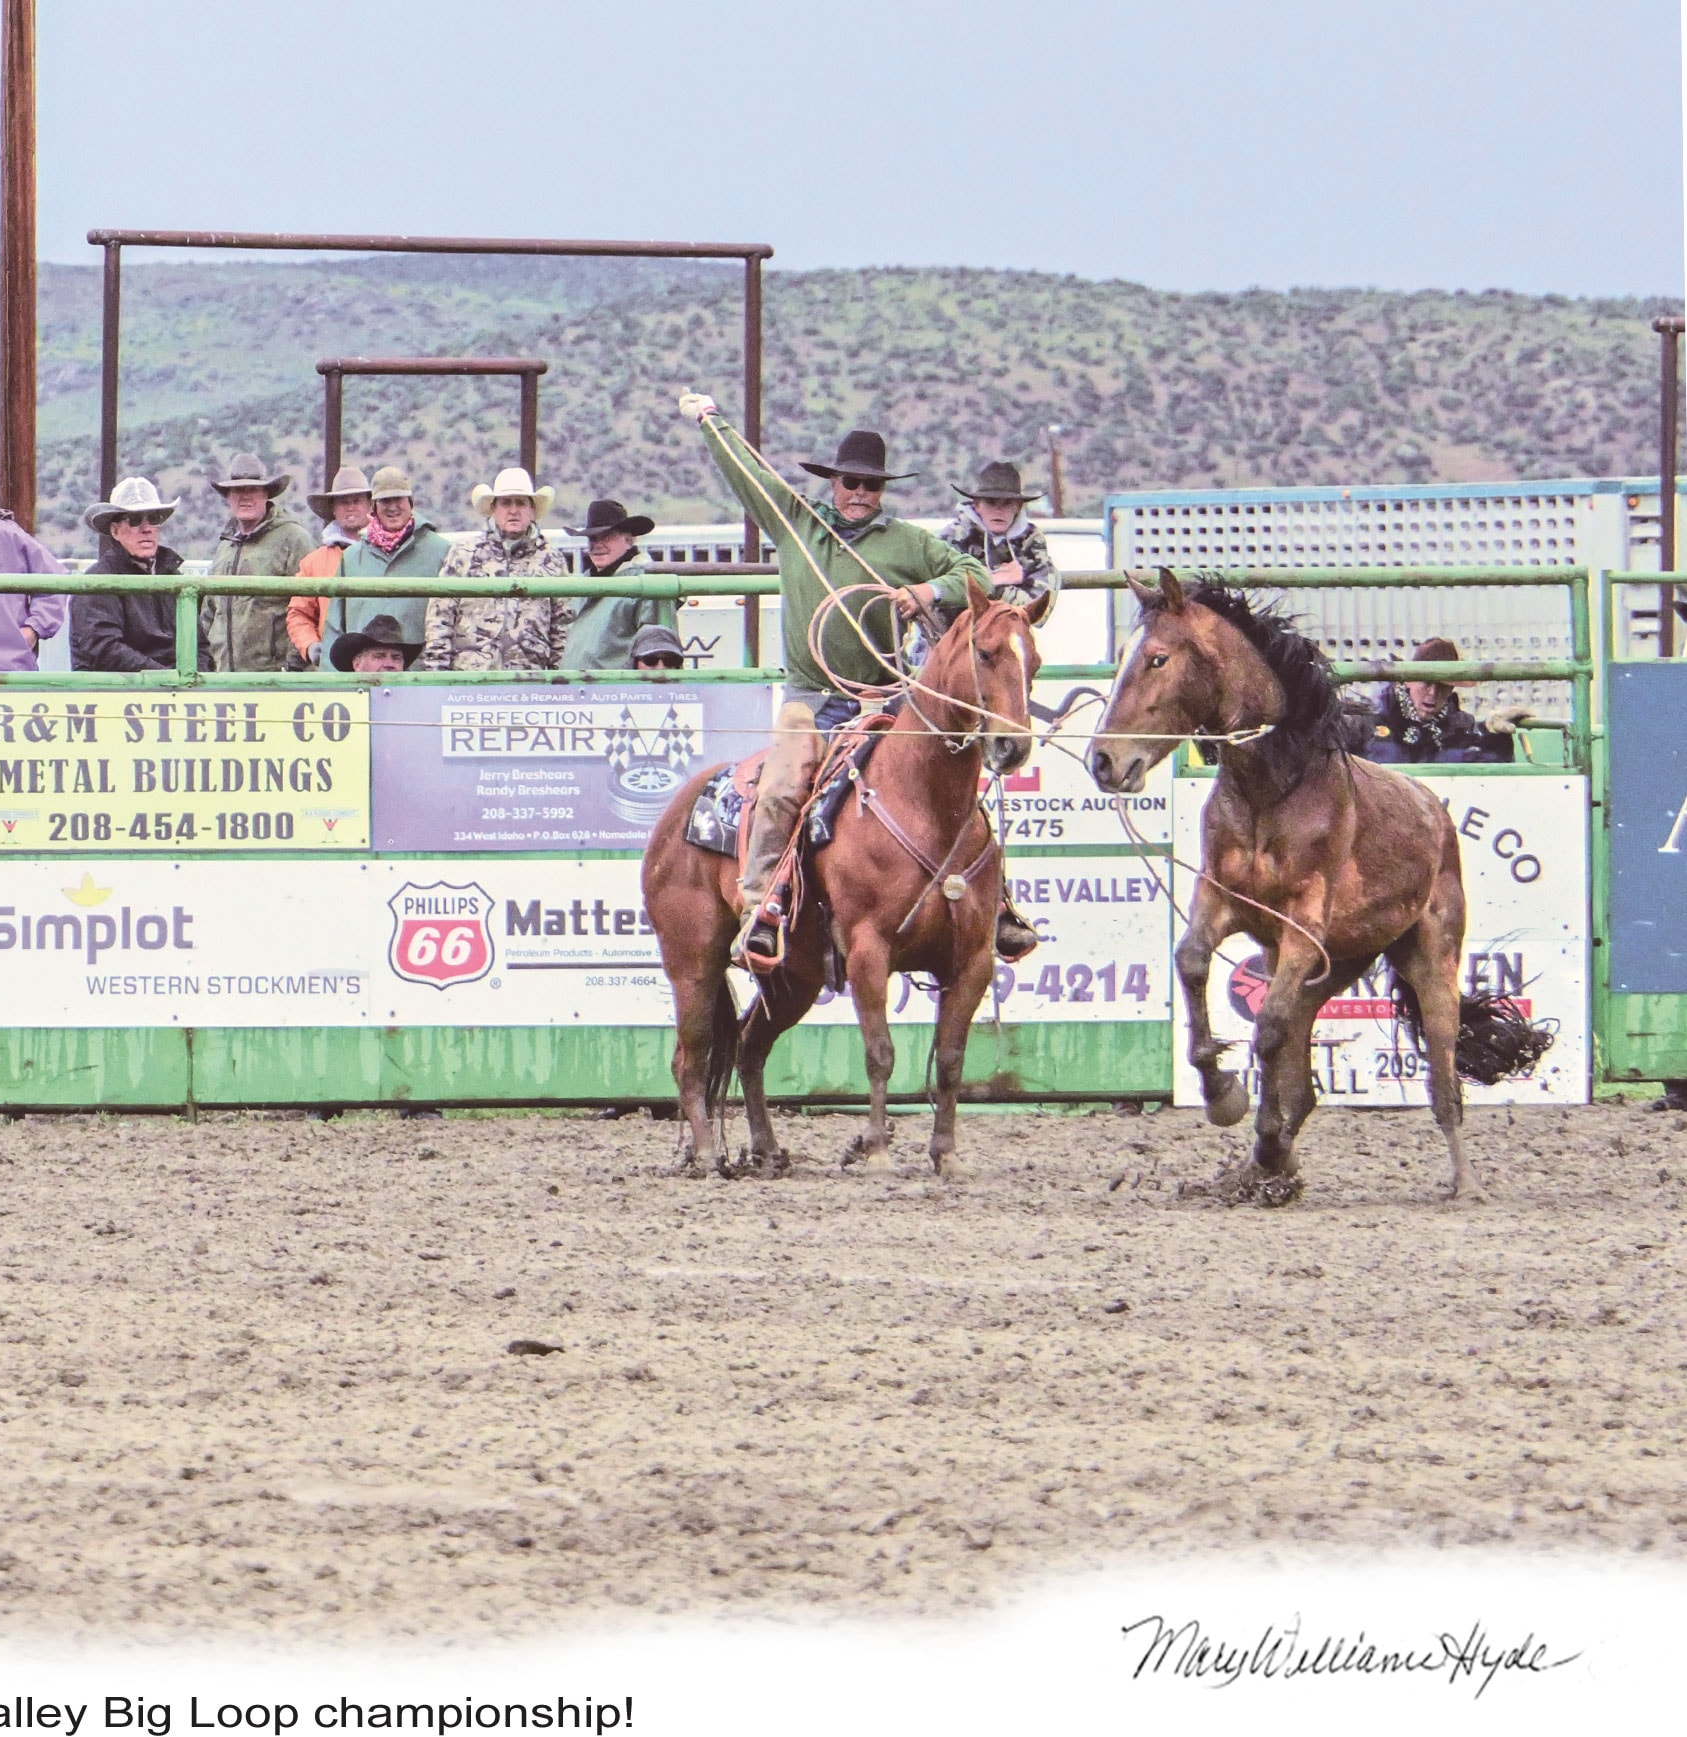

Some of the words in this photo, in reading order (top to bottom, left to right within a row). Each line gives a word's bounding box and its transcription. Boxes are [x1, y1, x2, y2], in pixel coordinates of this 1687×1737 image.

[124, 702, 266, 744] STEEL
[292, 701, 352, 743] CO
[450, 711, 594, 725] PERFECTION
[451, 726, 595, 751] REPAIR
[133, 757, 333, 793] BUILDINGS
[479, 769, 510, 781] Jerry
[512, 769, 574, 780] Breshears
[476, 785, 515, 797] Randy
[517, 785, 580, 796] Breshears
[481, 807, 574, 819] 208-337-5992
[49, 812, 294, 841] 208-454-1800
[453, 832, 472, 841] 334
[473, 831, 497, 841] West
[498, 831, 525, 841] Idaho
[572, 831, 590, 841] 628
[599, 830, 646, 840] Homedale
[993, 819, 1064, 838] -7475
[1055, 878, 1161, 902] VALLEY
[404, 897, 479, 915] PHILLIPS
[407, 926, 475, 966] 66
[505, 949, 550, 957] Petroleum
[553, 949, 593, 957] Products
[602, 949, 652, 957] Automotive
[86, 976, 199, 995] WESTERN
[207, 975, 361, 995] STOCKMEN'S
[585, 977, 657, 986] 208.337.4664
